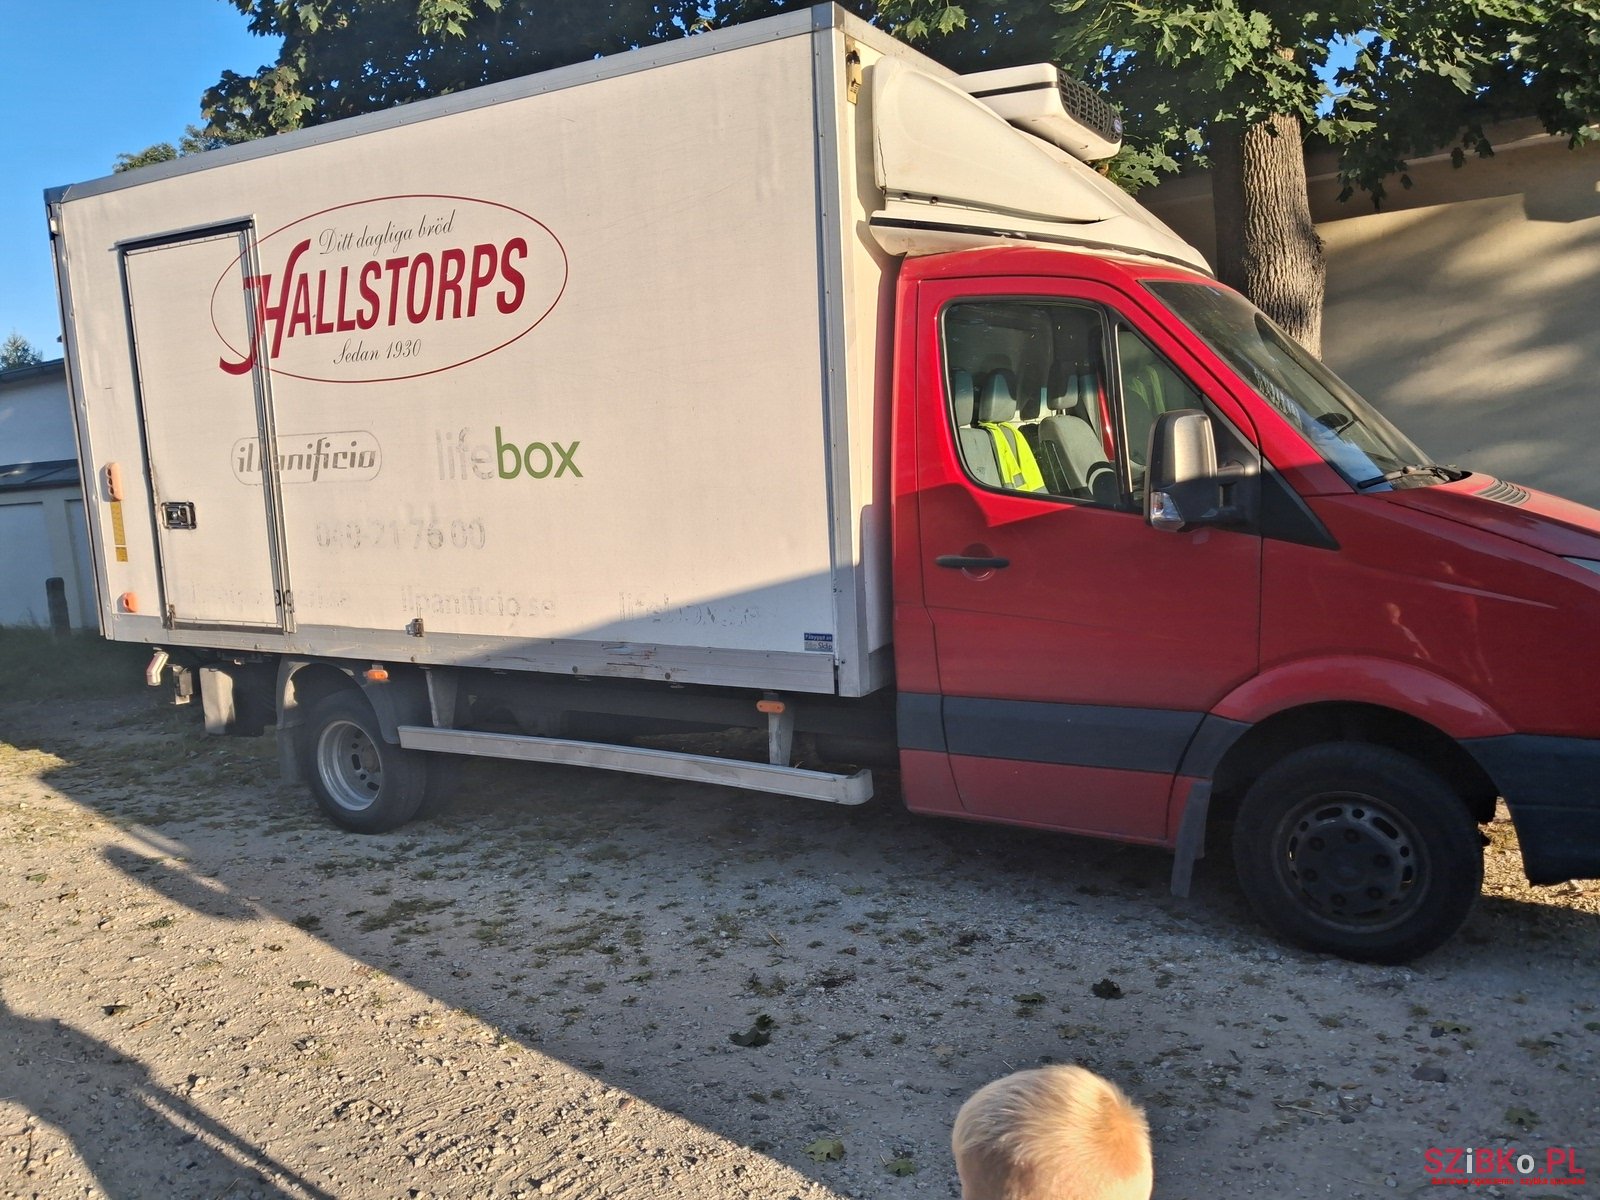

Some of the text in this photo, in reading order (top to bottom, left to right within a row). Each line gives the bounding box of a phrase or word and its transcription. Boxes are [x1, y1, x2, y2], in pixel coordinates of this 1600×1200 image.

[319, 209, 456, 257] Ditt dagliga bröd
[219, 236, 528, 376] HALLSTORPS
[333, 338, 422, 364] Sedan 1930
[258, 436, 377, 482] nificio
[436, 426, 584, 481] lifebox
